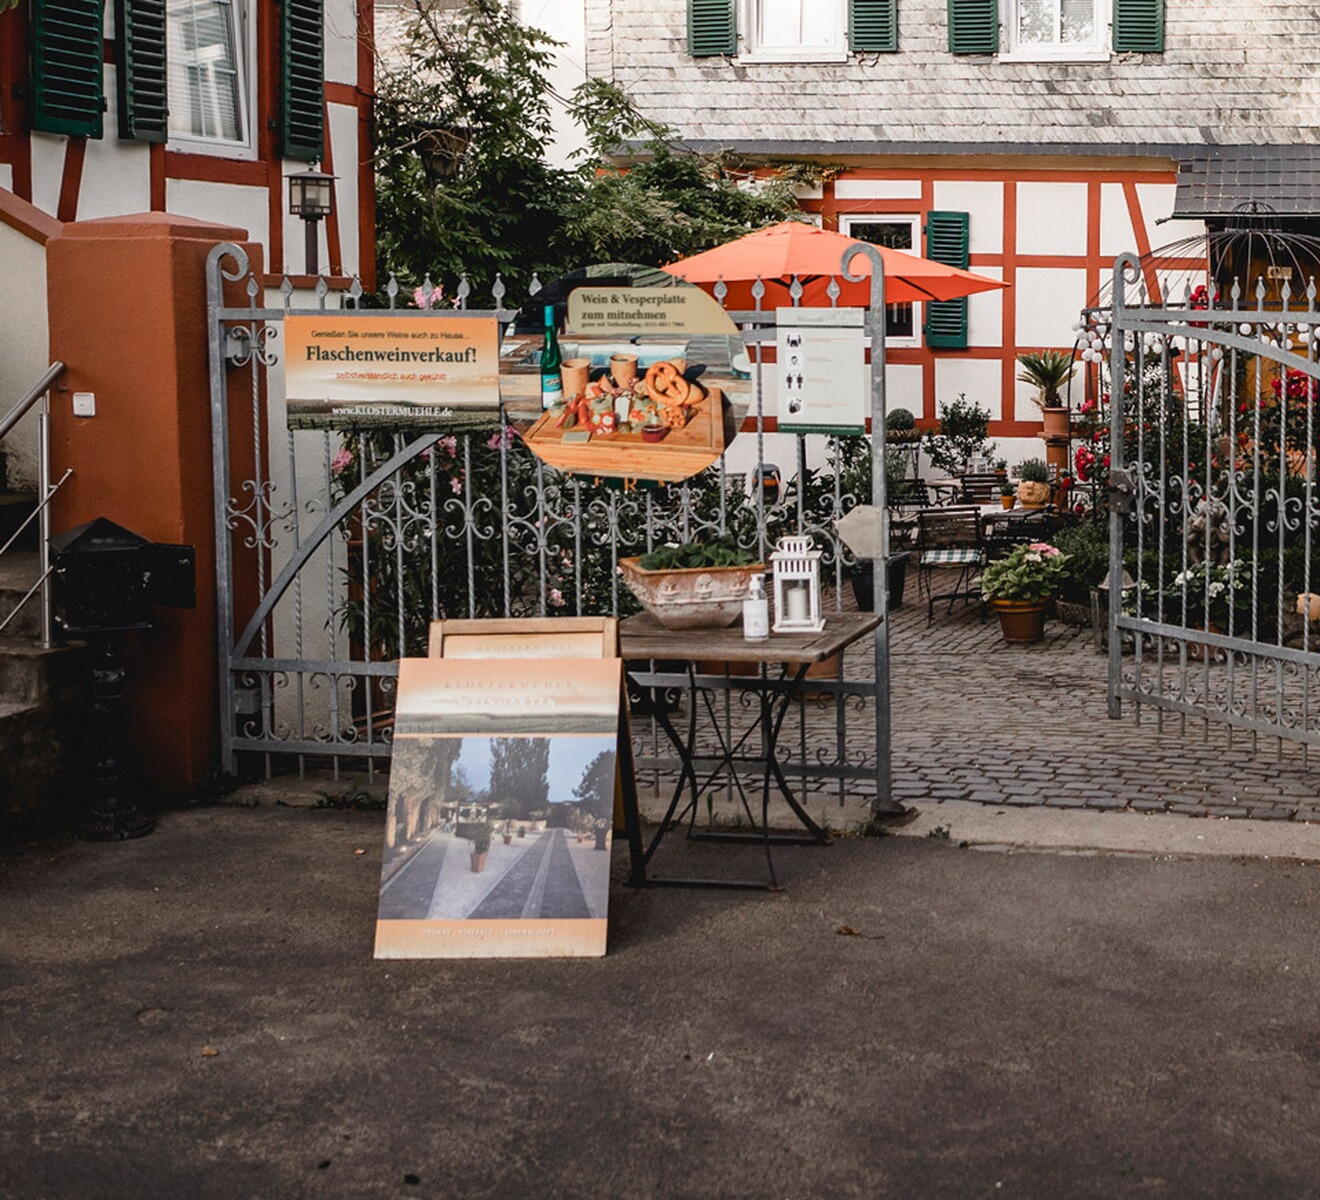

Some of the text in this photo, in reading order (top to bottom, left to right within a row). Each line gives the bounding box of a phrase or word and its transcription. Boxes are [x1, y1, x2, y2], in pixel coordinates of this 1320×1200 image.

[582, 294, 686, 306] Wein & Vesperplatte
[607, 309, 667, 320] mitnehmen
[311, 330, 346, 339] Genießen
[347, 330, 359, 339] Sie
[387, 331, 409, 339] Weine
[306, 345, 477, 363] Flaschenweinverkauf!
[332, 406, 453, 417] www.KLOSTERMUEHLE.de
